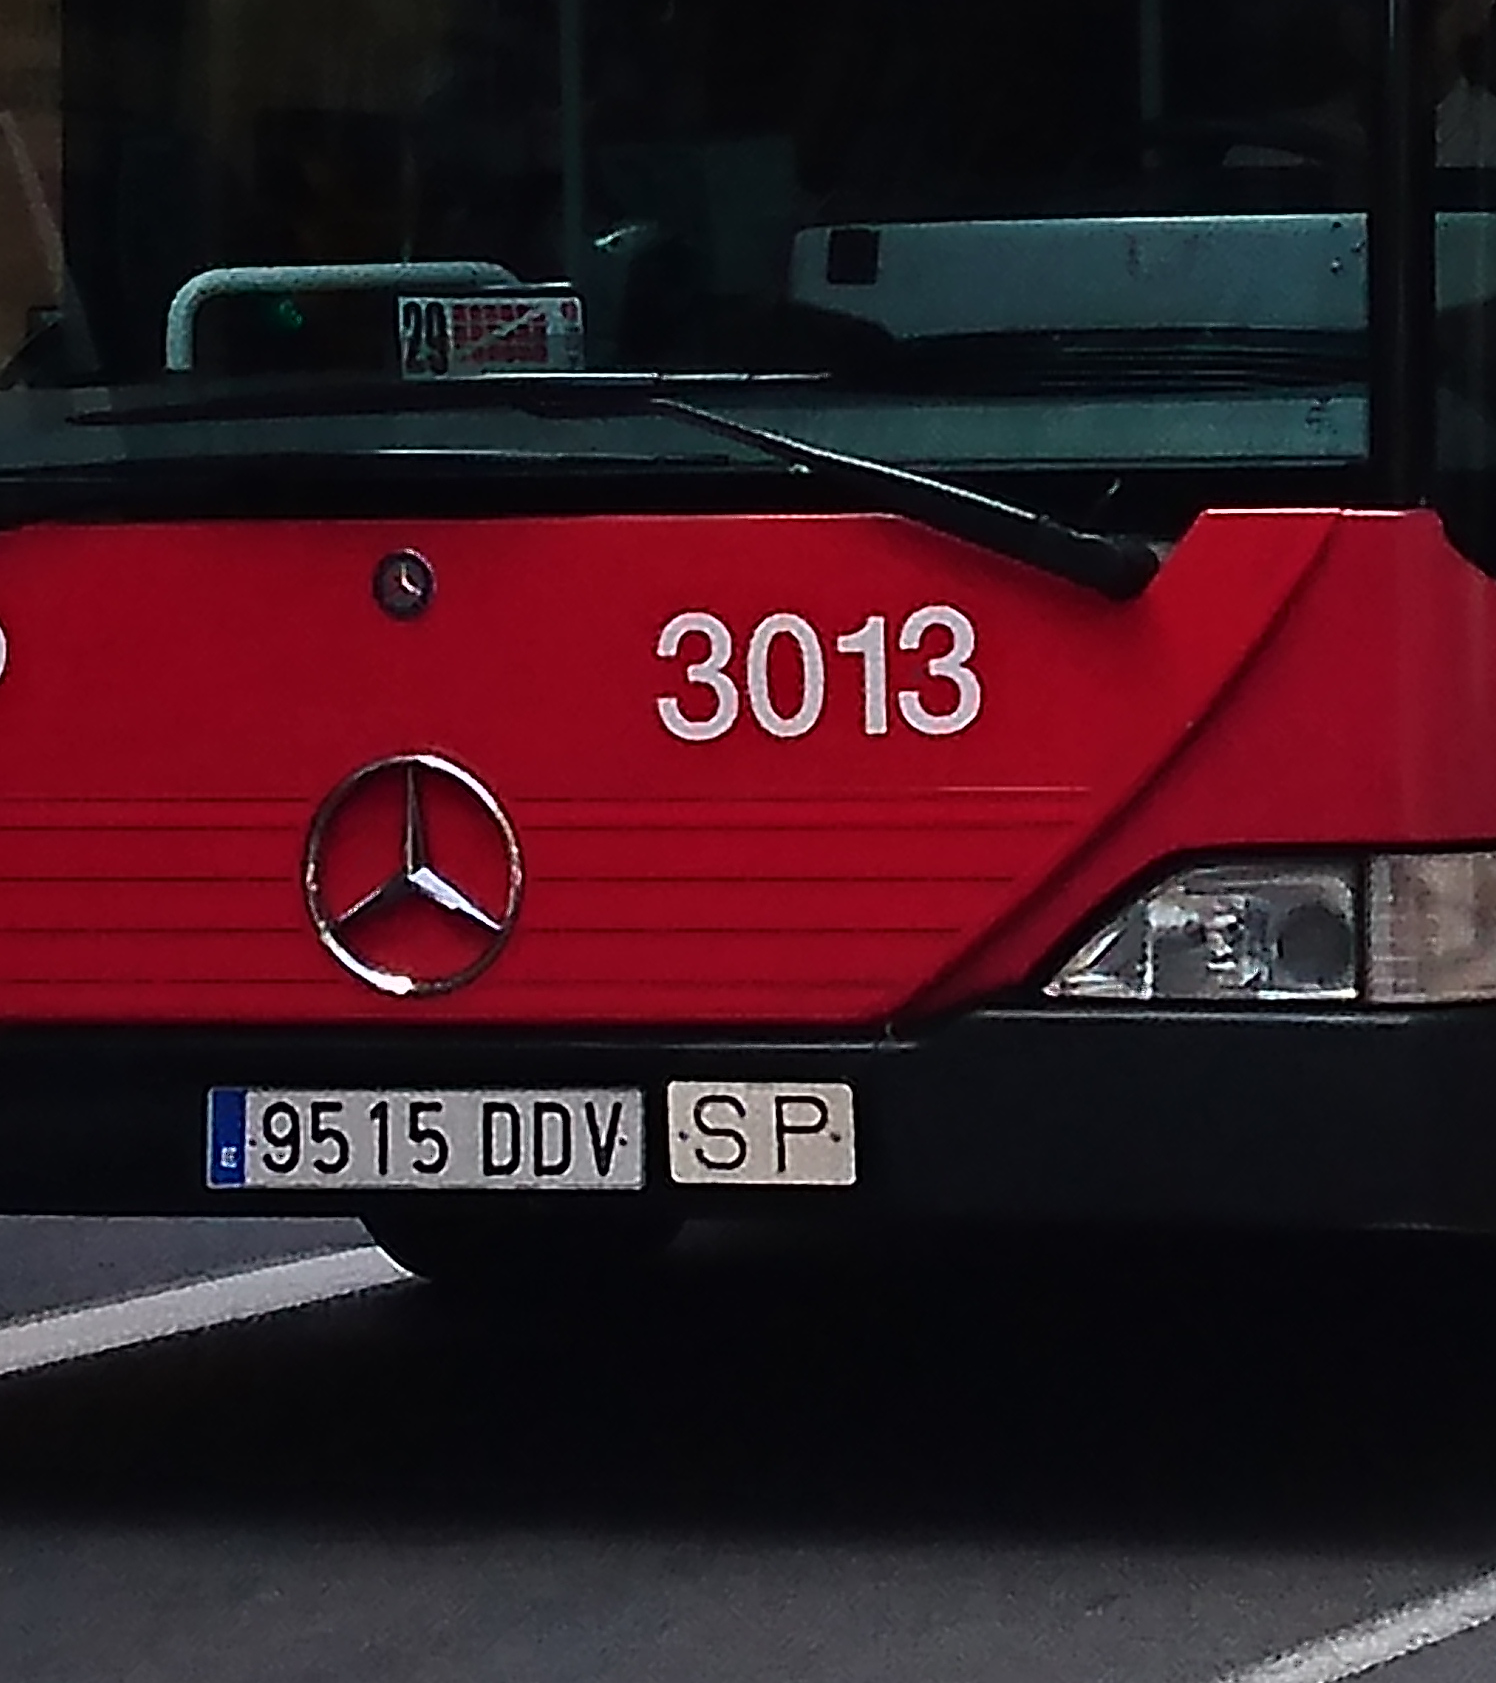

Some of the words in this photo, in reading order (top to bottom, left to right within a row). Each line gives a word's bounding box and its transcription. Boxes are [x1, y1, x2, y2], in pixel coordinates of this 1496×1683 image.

[656, 604, 982, 742] 3013
[260, 1099, 452, 1177] 9515
[481, 1099, 624, 1177] DDV
